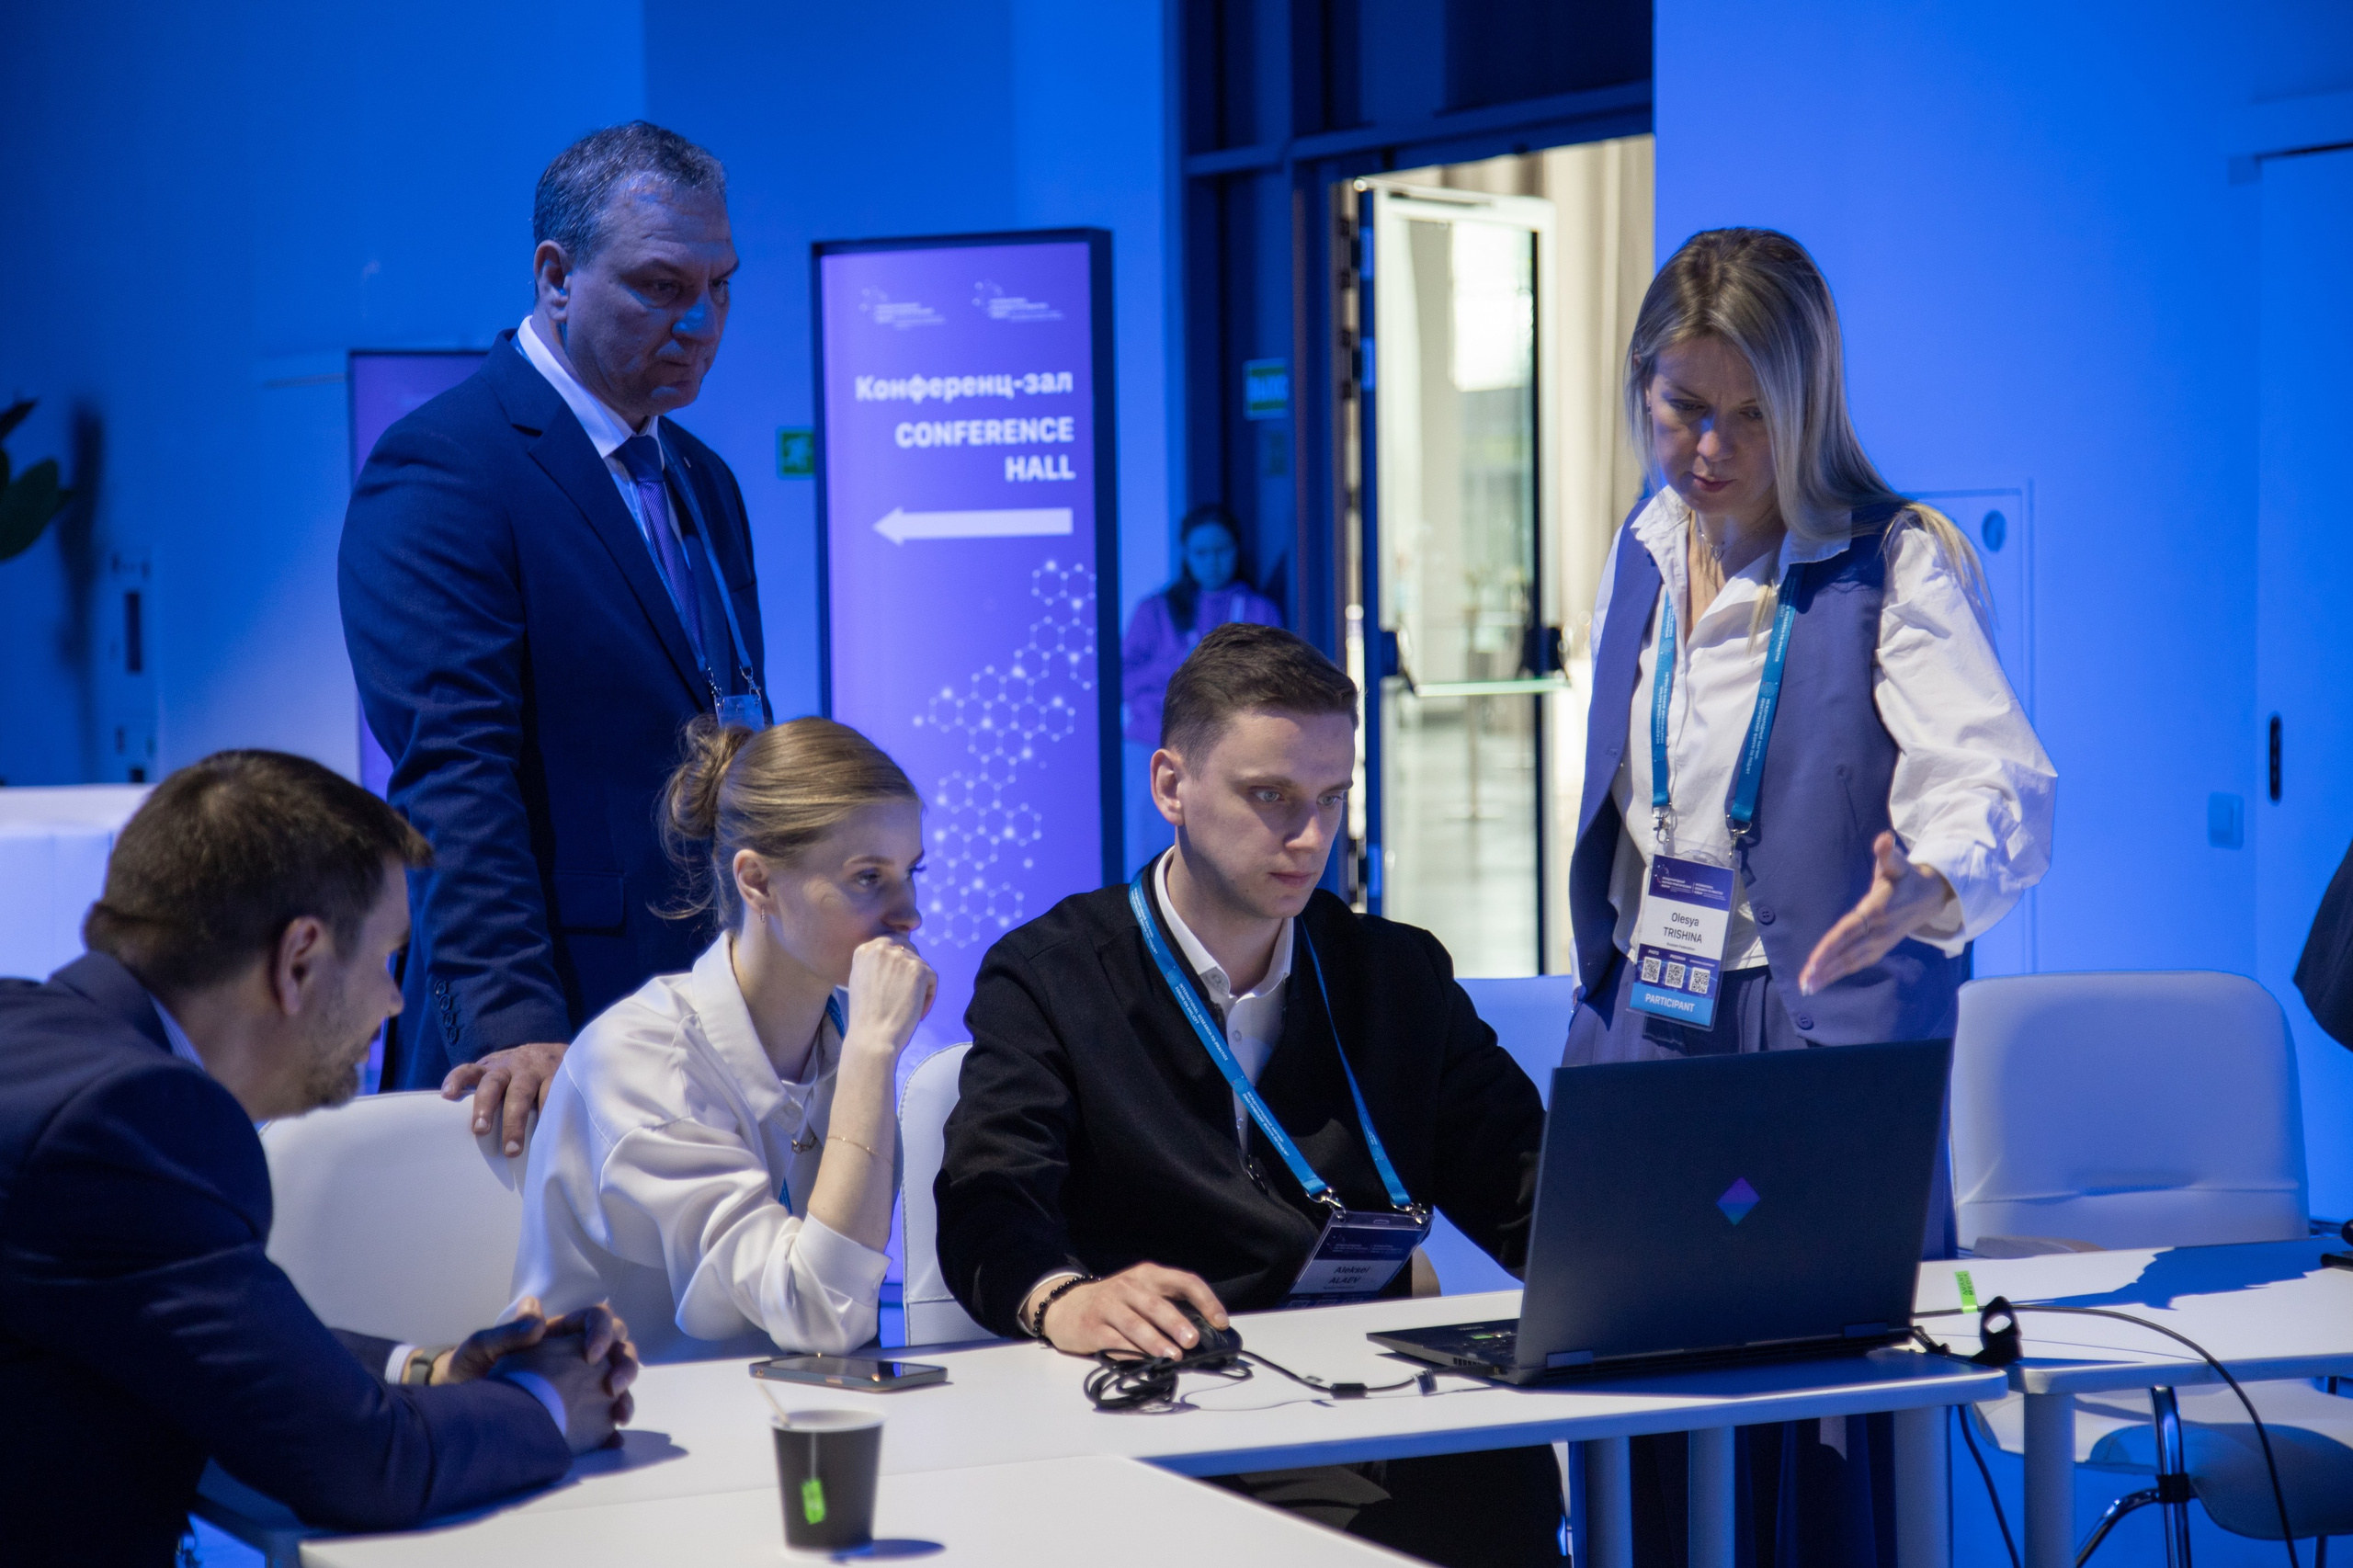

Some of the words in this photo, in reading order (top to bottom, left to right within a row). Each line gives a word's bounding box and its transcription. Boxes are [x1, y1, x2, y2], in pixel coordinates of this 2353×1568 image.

[855, 371, 1074, 404] Конференц-зал
[895, 416, 1074, 448] CONFERENCE
[1005, 454, 1076, 482] HALL
[1671, 912, 1699, 927] Olesya
[1663, 926, 1702, 944] TRISHINA
[1645, 993, 1695, 1012] PARTICIPANT
[1178, 983, 1199, 1014] INTERNATIONAL
[1197, 1013, 1228, 1061] RESEARCH-TO-PRACTICE
